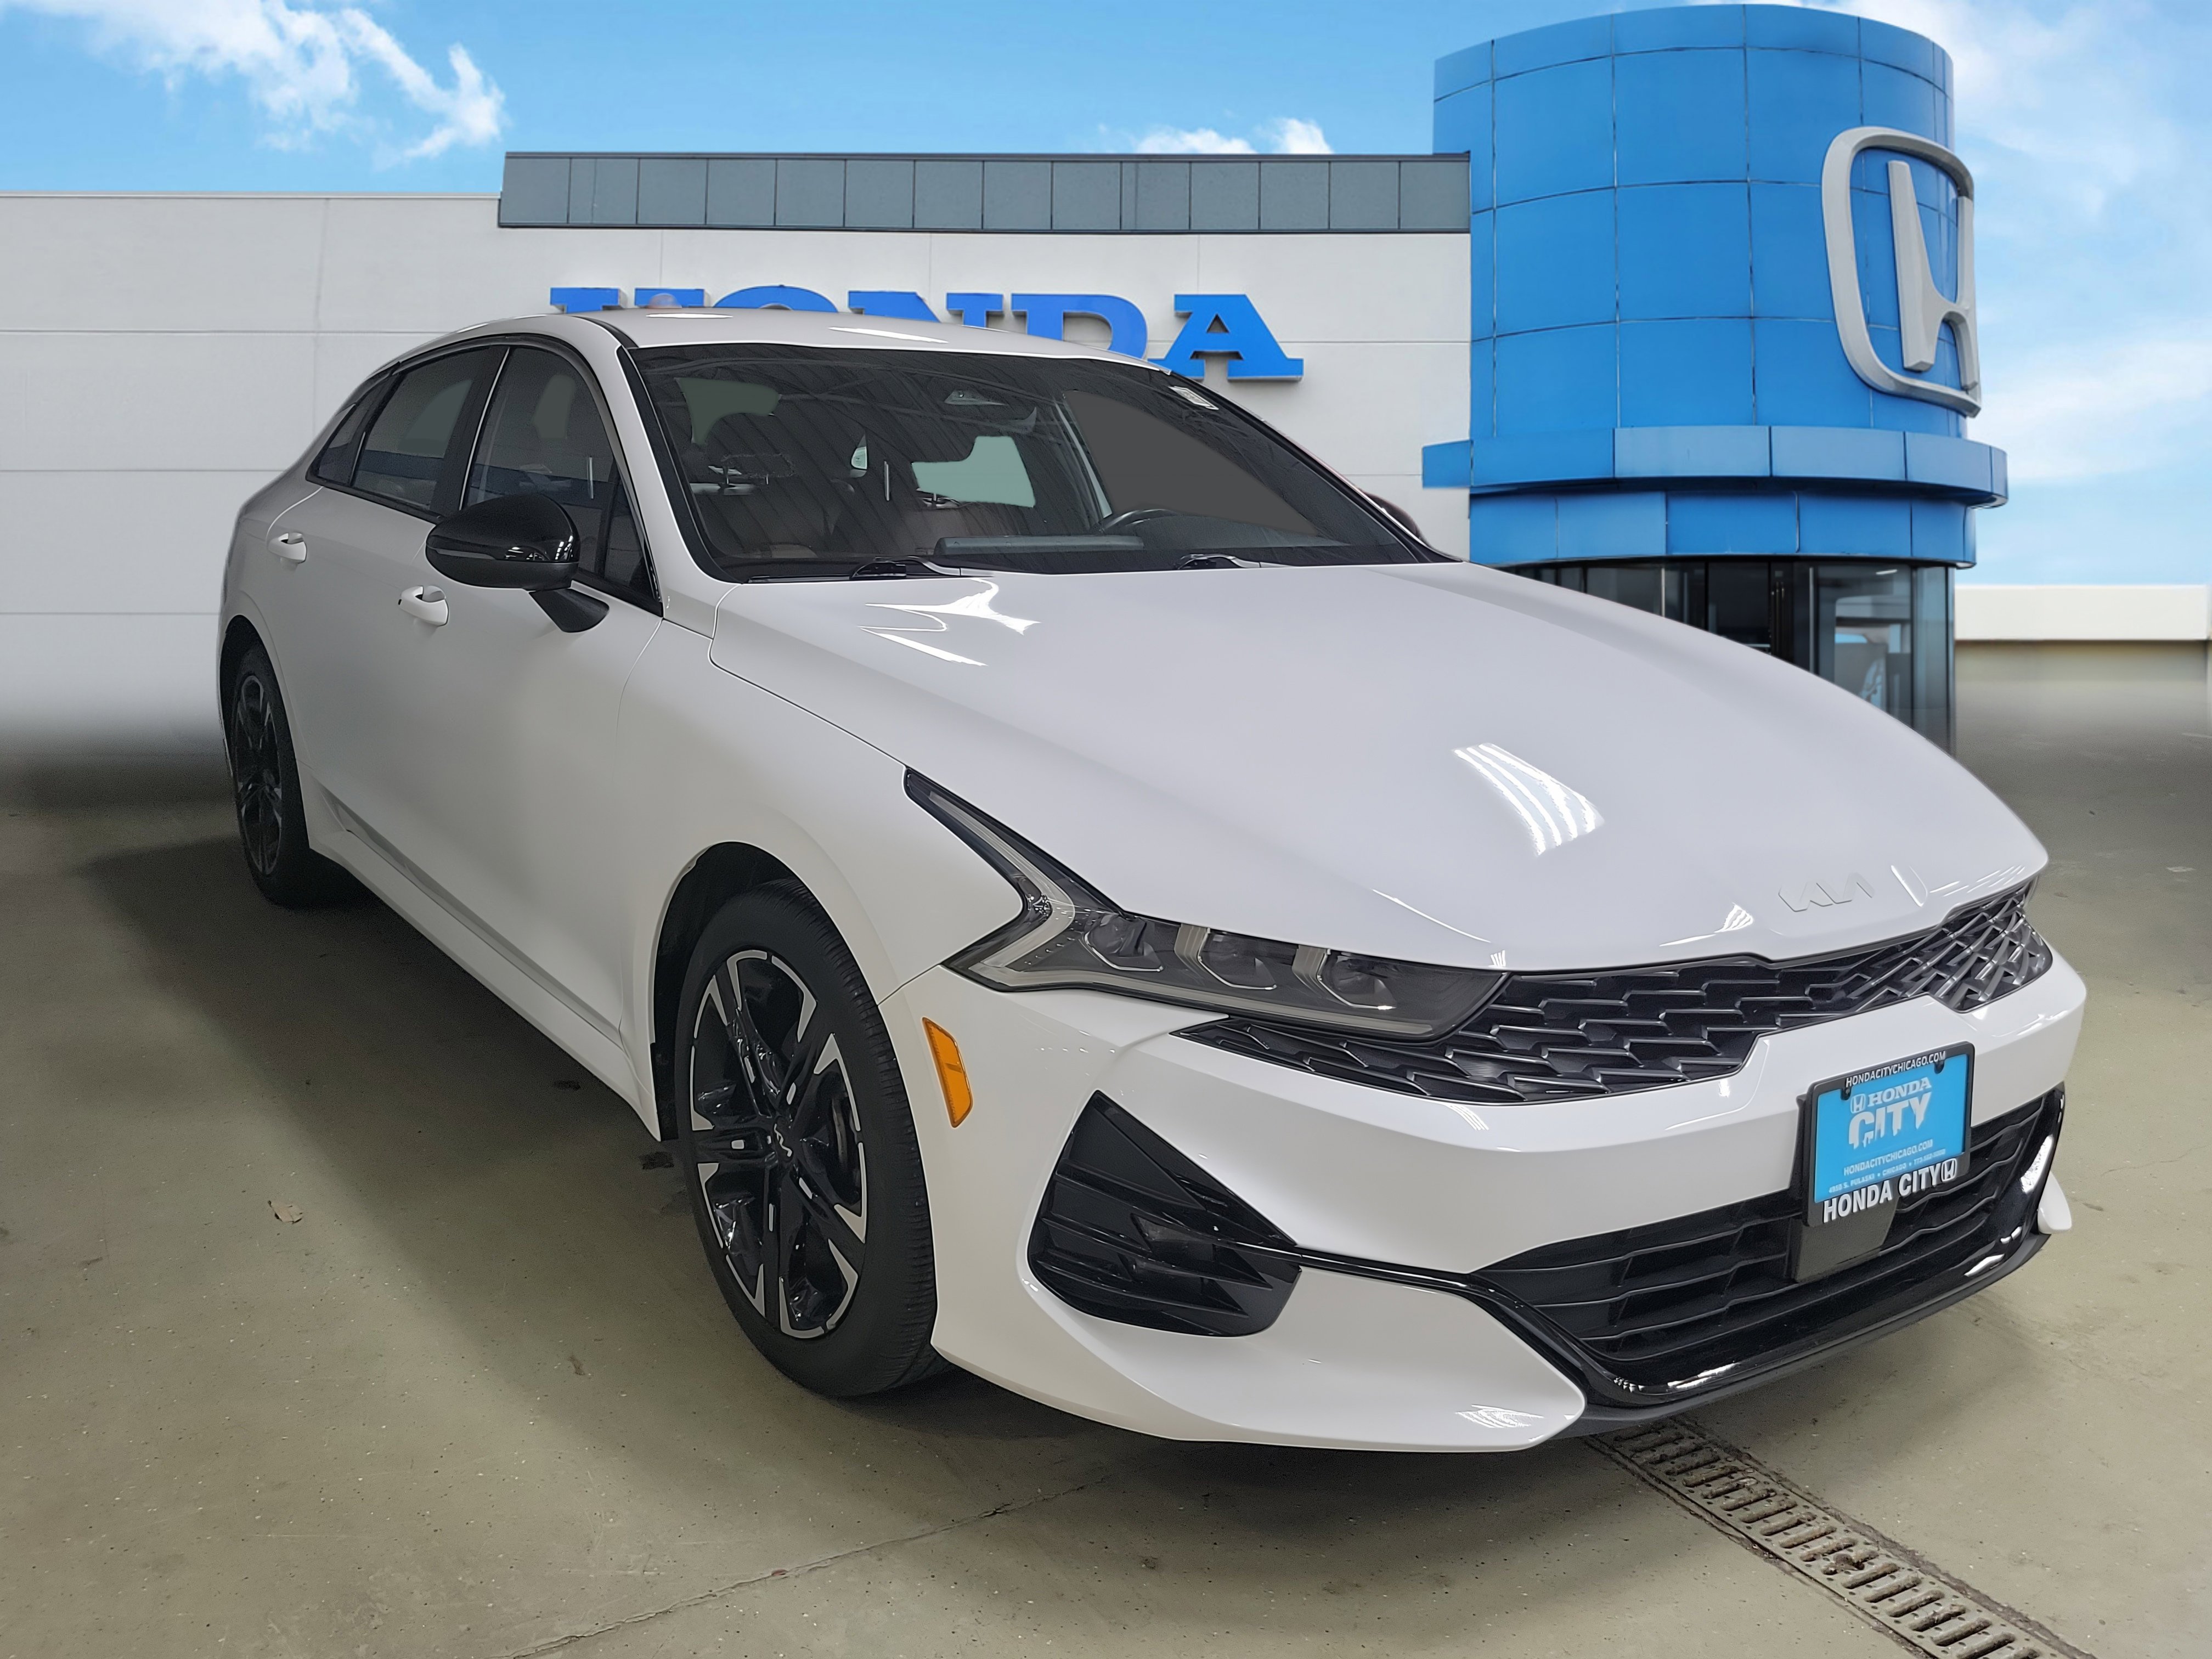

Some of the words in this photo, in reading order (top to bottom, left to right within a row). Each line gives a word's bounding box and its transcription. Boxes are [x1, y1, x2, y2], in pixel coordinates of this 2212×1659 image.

[1846, 1051, 1946, 1088] HONDACITYCHICAGO.COM
[1867, 1077, 1932, 1107] HONDA
[1848, 1092, 1932, 1150] CITY
[1843, 1138, 1933, 1176] HONDACITYCHICAGO.COM
[1850, 1173, 1875, 1186] PULASKI
[1882, 1163, 1907, 1176] CHICAGO
[1823, 1180, 1893, 1223] HONDA
[1898, 1163, 1942, 1197] CITY
